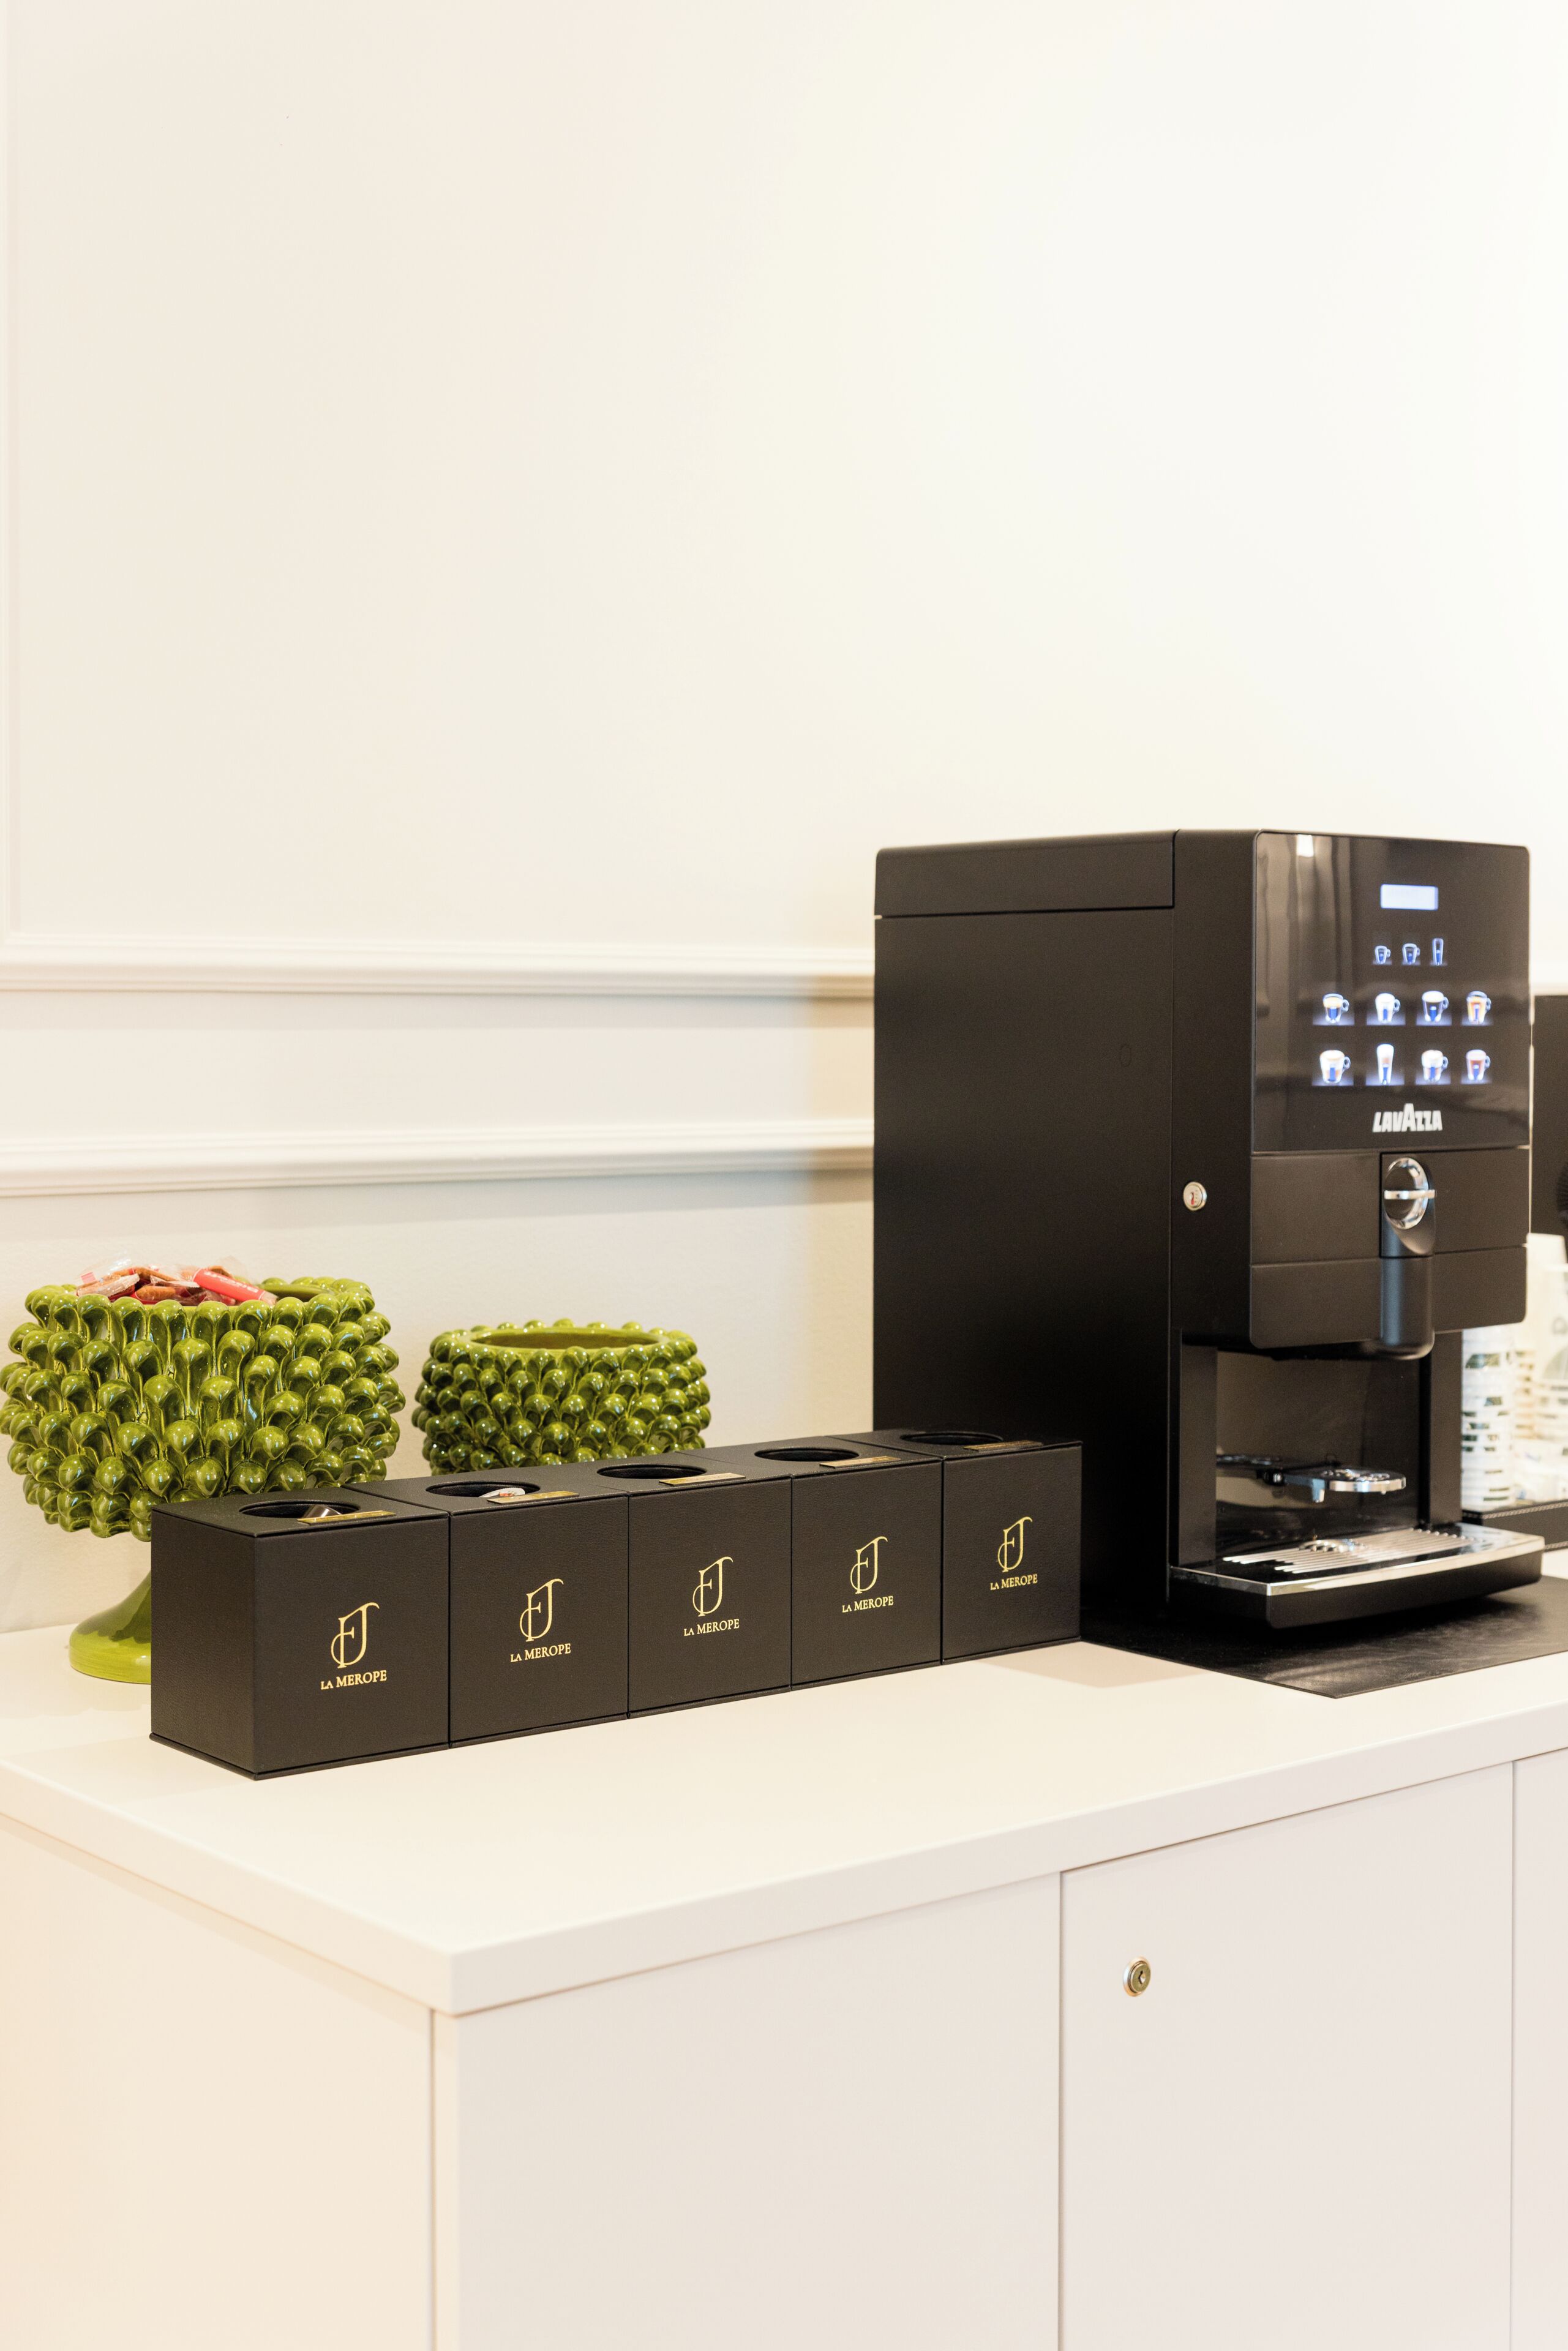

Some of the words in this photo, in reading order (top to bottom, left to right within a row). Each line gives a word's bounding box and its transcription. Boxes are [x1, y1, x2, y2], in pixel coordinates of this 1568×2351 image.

[1372, 1103, 1443, 1133] LAVAZZA
[990, 1582, 1000, 1591] LA
[1001, 1573, 1038, 1589] MEROPE
[842, 1604, 852, 1613] LA
[853, 1595, 894, 1611] MEROPE
[683, 1627, 695, 1637] LA
[696, 1618, 740, 1635] MEROPE
[510, 1653, 522, 1663] LA
[524, 1644, 571, 1660] MEROPE
[320, 1680, 334, 1690] LA
[336, 1670, 388, 1688] MEROPE
